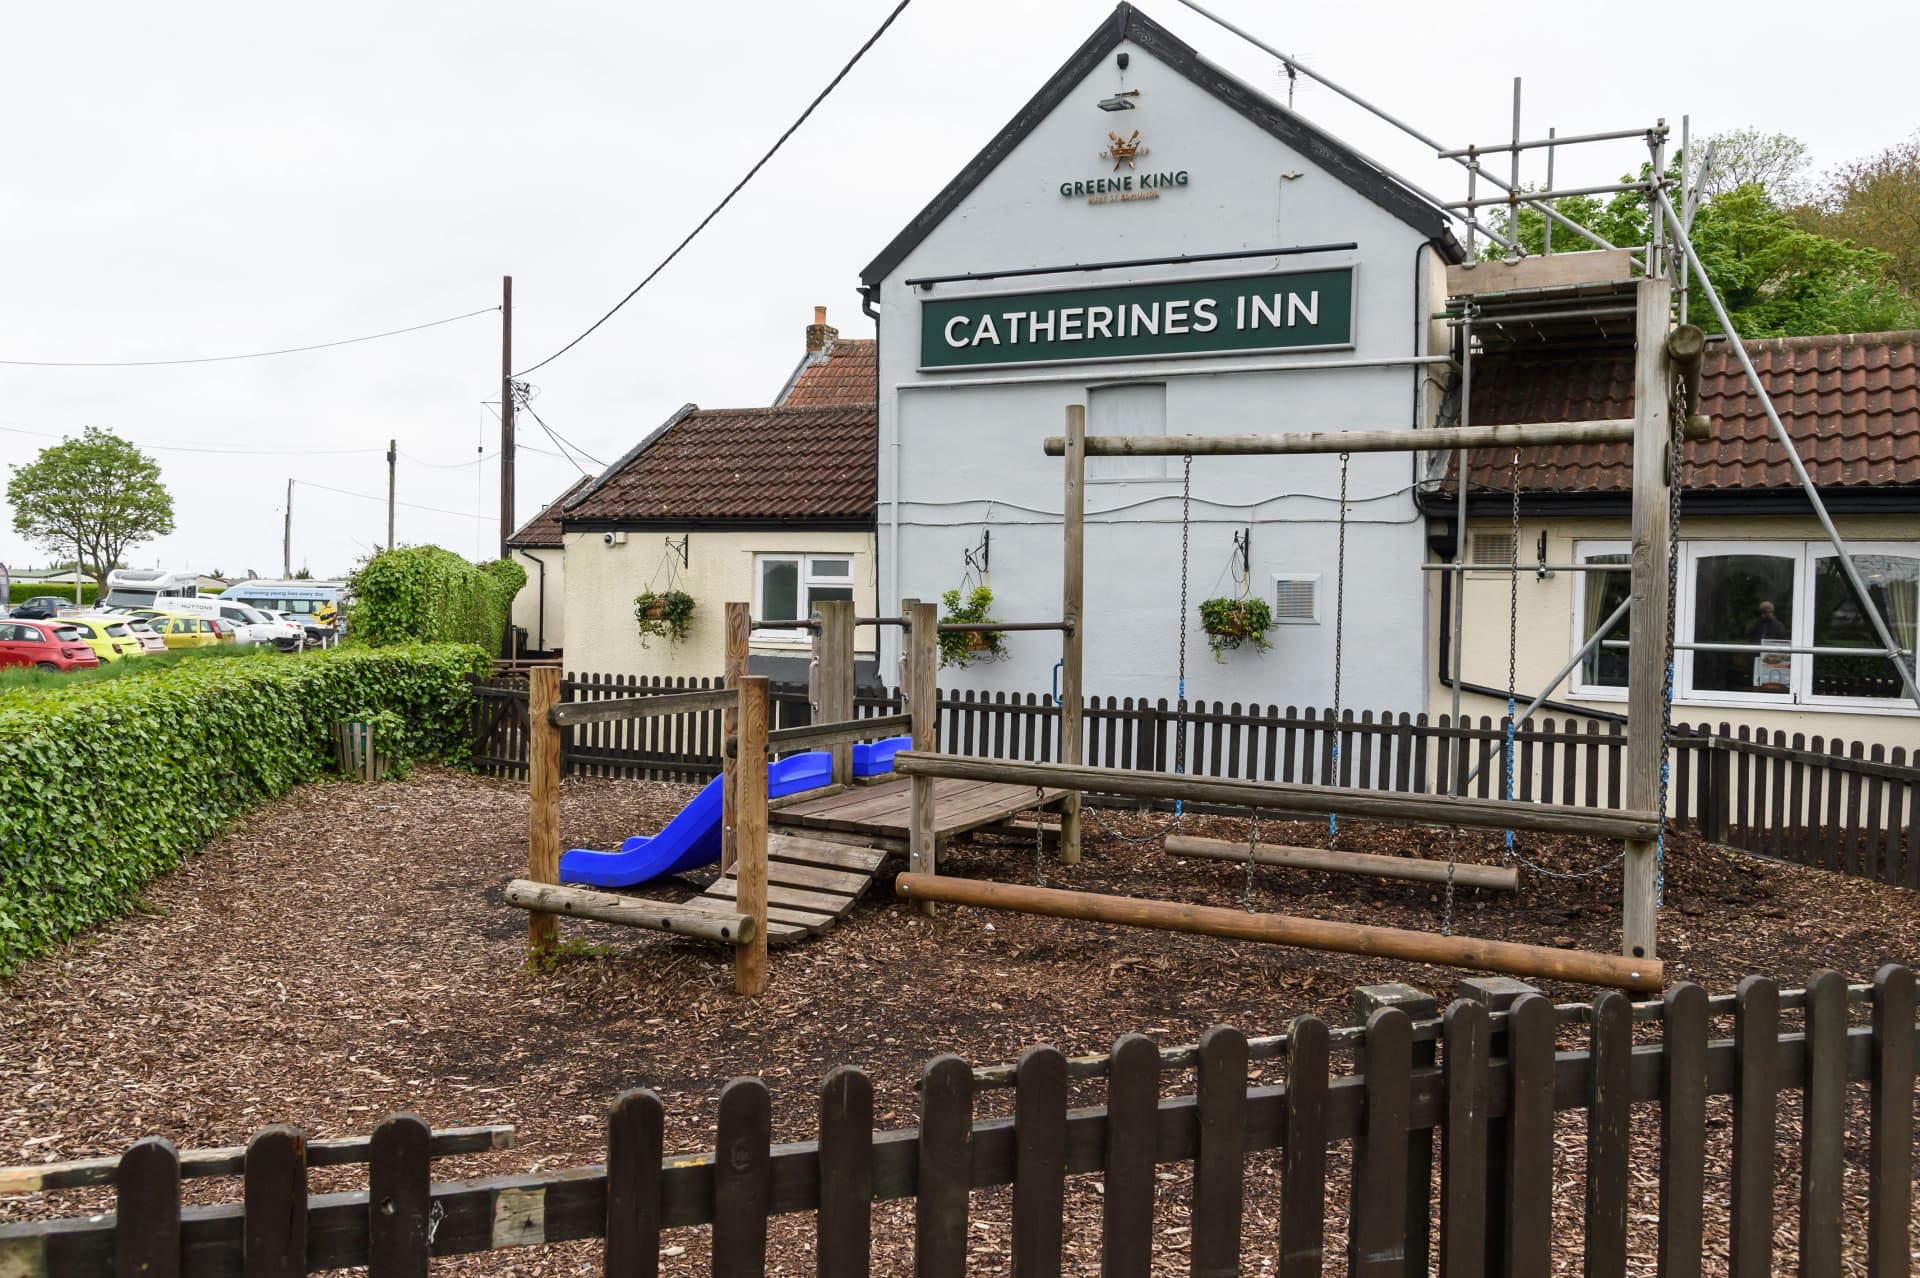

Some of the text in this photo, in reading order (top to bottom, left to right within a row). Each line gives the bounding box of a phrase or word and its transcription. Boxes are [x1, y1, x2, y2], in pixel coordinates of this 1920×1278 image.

[1060, 171, 1189, 197] GREENE KING
[944, 290, 1320, 348] CATHERINES INN
